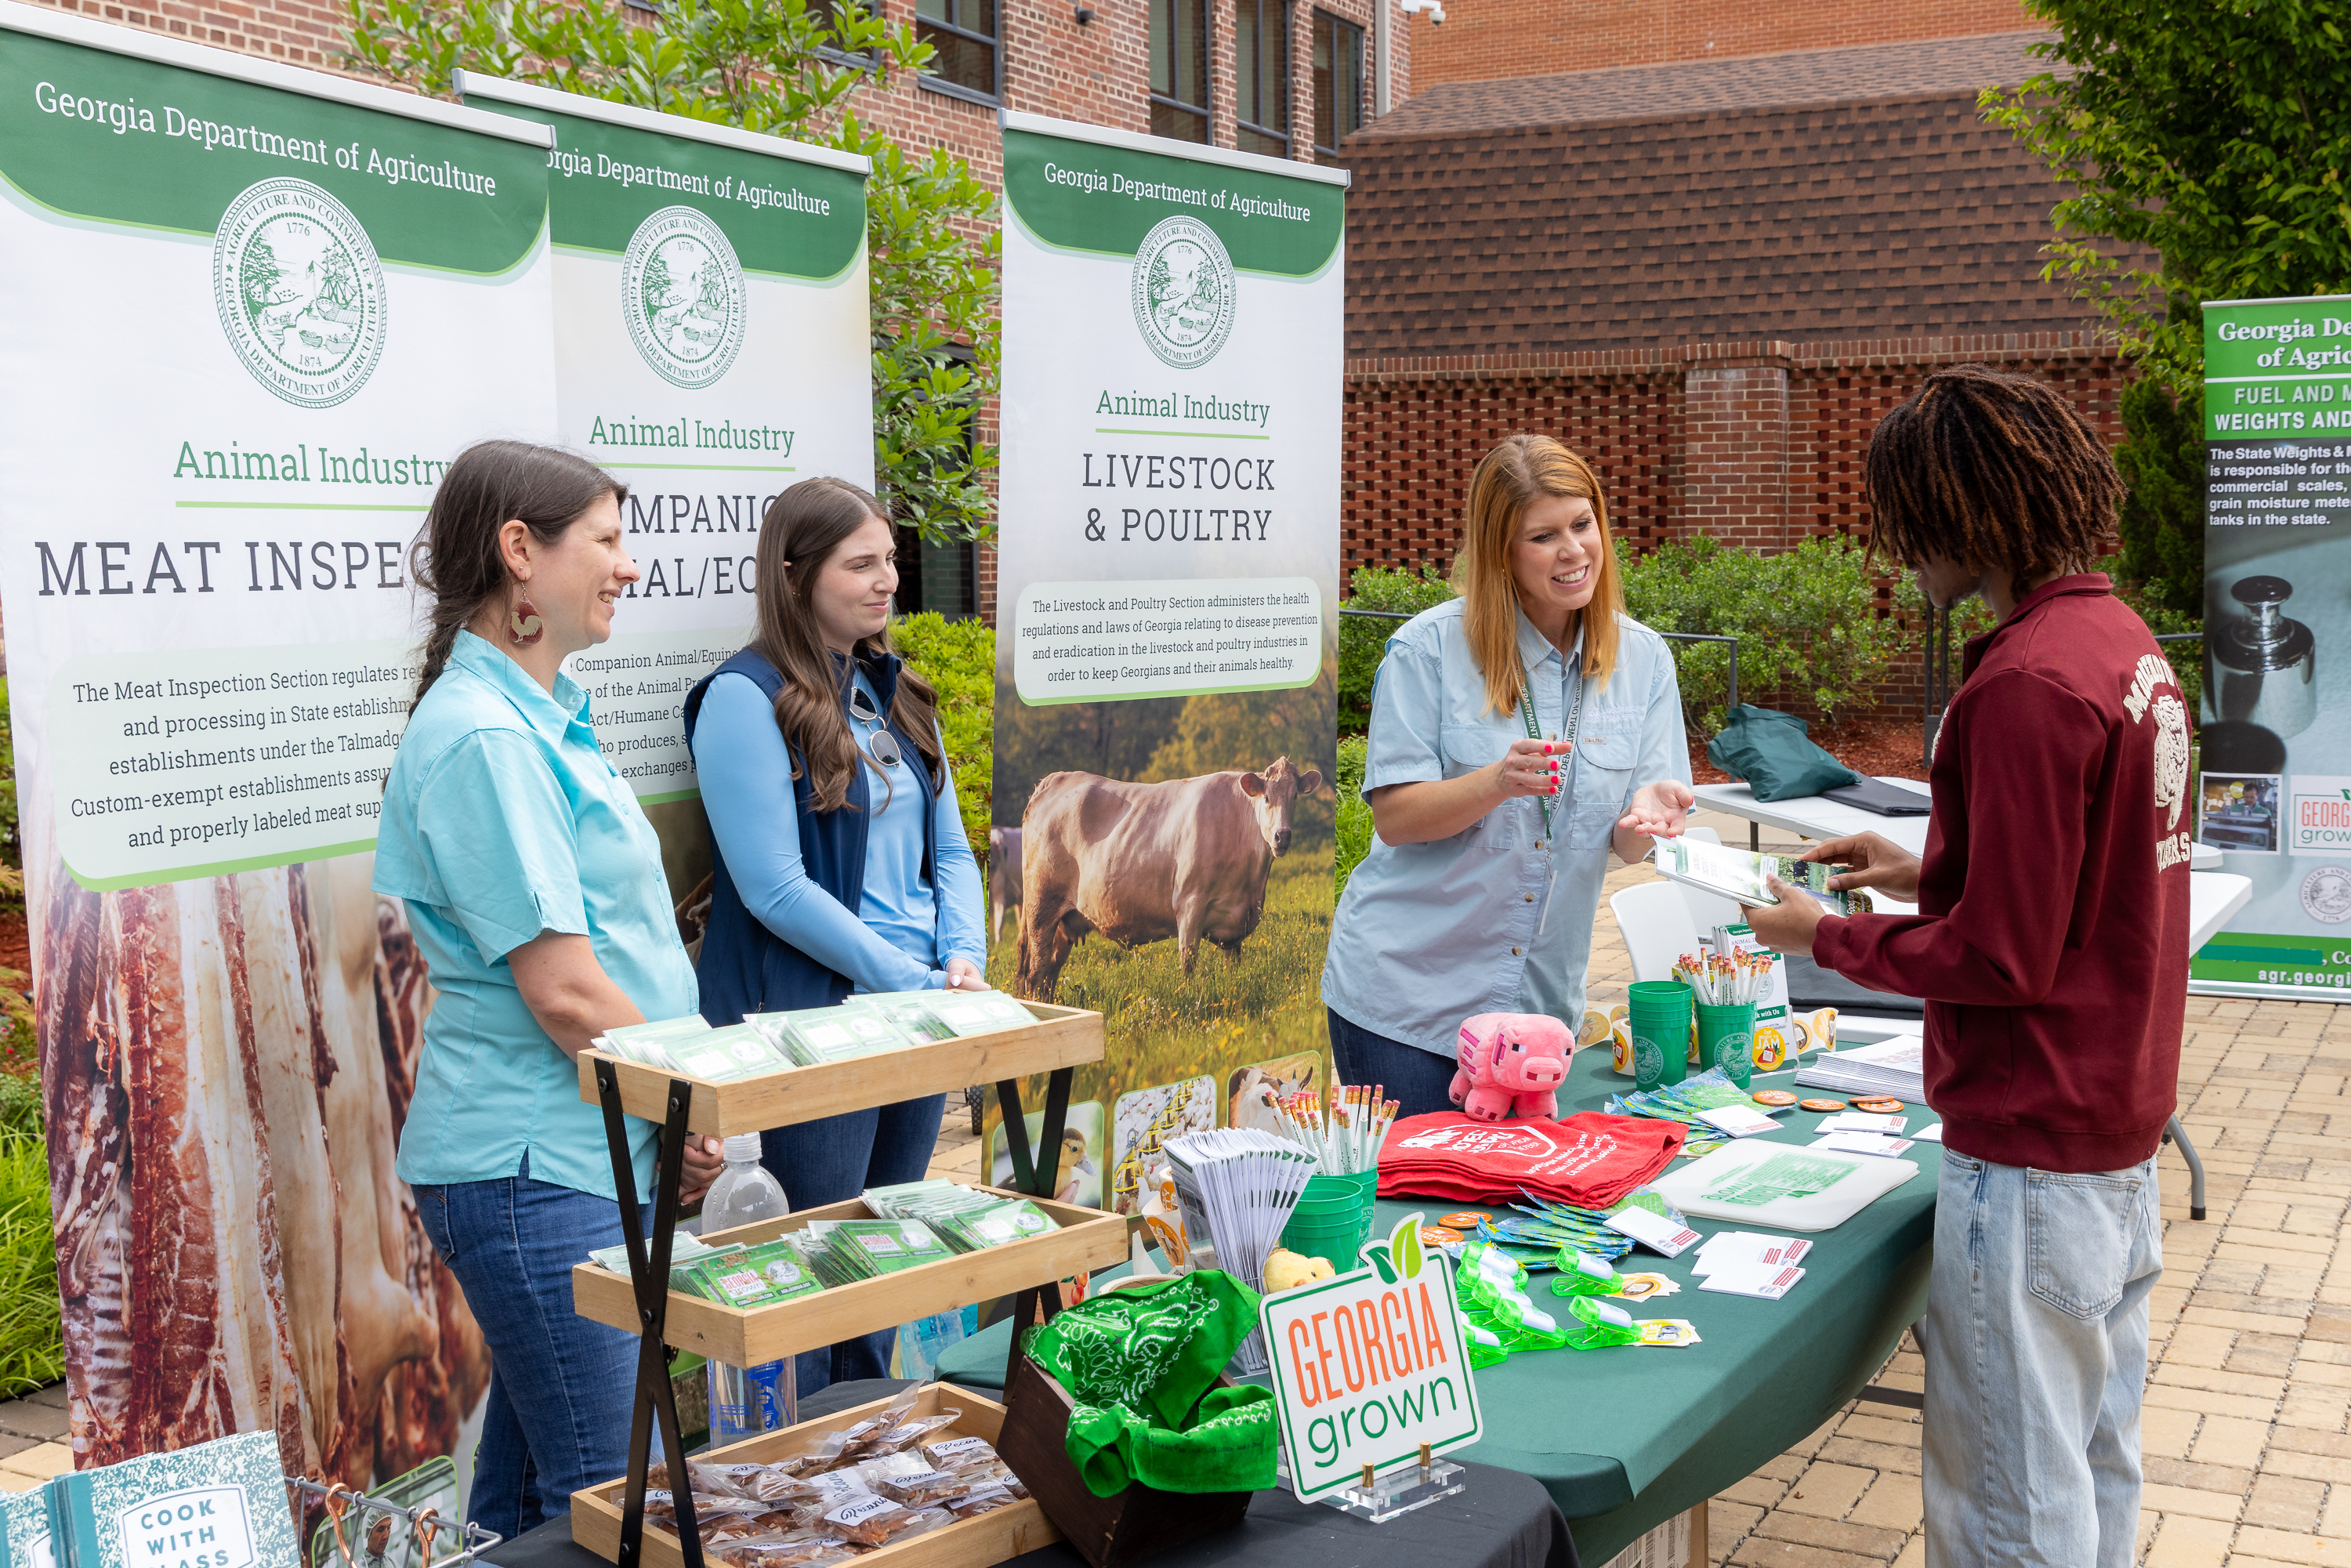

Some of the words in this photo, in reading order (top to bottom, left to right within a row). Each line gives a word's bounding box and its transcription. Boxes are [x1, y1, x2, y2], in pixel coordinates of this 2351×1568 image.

[34, 81, 156, 136] Georgia
[163, 105, 327, 165] Department
[335, 142, 360, 171] of
[366, 147, 497, 197] Agriculture
[597, 154, 710, 195] Department
[715, 176, 731, 198] of
[737, 180, 830, 215] Agriculture
[1045, 162, 1107, 194] Georgia
[1112, 172, 1207, 207] Department
[1211, 190, 1226, 208] of
[1230, 192, 1310, 222] Agriculture
[226, 193, 291, 261] AGRICULTURE
[292, 194, 316, 210] AND
[317, 203, 373, 279] COMMERCE
[286, 221, 310, 237] 1776
[224, 277, 252, 349] GEORGIA
[248, 345, 326, 396] DEPARTMENT
[327, 382, 342, 394] OF
[342, 294, 377, 386] AGRICULTURE
[2218, 318, 2316, 343] Georgia
[299, 353, 322, 368] 1874
[2257, 347, 2285, 368] of
[2234, 387, 2285, 404] FUEL
[2292, 385, 2334, 403] AND
[1096, 390, 1177, 418] Animal
[1183, 395, 1270, 429] Industry
[2215, 411, 2305, 430] WEIGHTS
[589, 415, 688, 447] Animal
[695, 420, 795, 458] Industry
[173, 440, 310, 482] Animal
[2210, 448, 2233, 461] The
[2235, 447, 2272, 459] State
[2273, 446, 2331, 461] Weights
[2333, 446, 2344, 458] &
[1083, 454, 1275, 491] LIVESTOCK
[2210, 465, 2221, 476] is
[2224, 462, 2306, 478] responsible
[2310, 462, 2331, 475] for
[2209, 480, 2288, 493] commercial
[2297, 480, 2348, 493] scales,
[2209, 498, 2242, 512] grain
[2248, 498, 2310, 509] moisture
[1085, 508, 1106, 541] &
[1121, 509, 1272, 541] POULTRY
[2209, 514, 2244, 526] tanks
[2248, 514, 2261, 525] in
[2265, 513, 2288, 526] the
[2291, 513, 2331, 525] state.
[34, 541, 220, 596] MEAT
[1032, 601, 1051, 614] The
[1053, 599, 1106, 613] Livestock
[1108, 598, 1128, 610] and
[1131, 598, 1167, 612] Poultry
[1168, 596, 1205, 609] Section
[1208, 594, 1265, 607] administers
[1266, 594, 1281, 606] the
[1283, 592, 1310, 605] health
[1022, 624, 1079, 639] regulations
[1081, 621, 1103, 635] and
[1106, 621, 1130, 633] laws
[1132, 620, 1143, 632] of
[1144, 619, 1183, 633] Georgia
[1184, 617, 1221, 632] relating
[1223, 618, 1233, 628] to
[1236, 616, 1270, 628] disease
[1273, 614, 1318, 628] prevention
[1032, 647, 1051, 660] and
[1053, 644, 1115, 659] eradication
[1118, 643, 1128, 656] in
[1131, 643, 1147, 655] the
[1150, 640, 1194, 654] livestock
[1196, 640, 1214, 653] and
[1216, 639, 1251, 654] poultry
[1254, 636, 1297, 650] industries
[1299, 636, 1308, 646] in
[576, 654, 651, 673] Companion
[1048, 669, 1075, 683] order
[1078, 668, 1089, 680] to
[1092, 667, 1118, 682] keep
[1121, 665, 1171, 679] Georgians
[1173, 664, 1191, 675] and
[1194, 661, 1216, 674] their
[1219, 659, 1258, 672] animals
[1259, 657, 1295, 672] healthy.
[73, 683, 109, 703] The
[114, 679, 163, 701] Meat
[168, 675, 266, 699] Inspection
[270, 669, 328, 690] Section
[331, 664, 398, 688] regulates
[596, 685, 607, 697] of
[612, 683, 632, 697] the
[637, 678, 682, 695] Animal
[123, 716, 160, 737] and
[165, 709, 266, 737] processing
[270, 707, 287, 724] in
[292, 704, 329, 722] State
[110, 745, 255, 775] establishments
[259, 741, 306, 761] under
[311, 737, 334, 755] the
[618, 734, 679, 755] produces,
[621, 759, 687, 778] exchanges
[71, 783, 224, 817] Custom-exempt
[229, 770, 350, 799] establishments
[129, 826, 165, 847] and
[170, 815, 248, 847] properly
[253, 806, 311, 832] labeled
[315, 802, 351, 823] meat
[2302, 802, 2349, 827] GEORG
[2302, 830, 2351, 843] grow
[1756, 1039, 1780, 1049] JAM
[1649, 1043, 1661, 1077] COMMERCE
[860, 1236, 893, 1245] GEORGIA
[730, 1283, 764, 1294] grown
[1288, 1282, 1447, 1408] GEORGIA
[1308, 1377, 1457, 1468] grown
[141, 1499, 216, 1530] COOK
[147, 1526, 215, 1555] WITH
